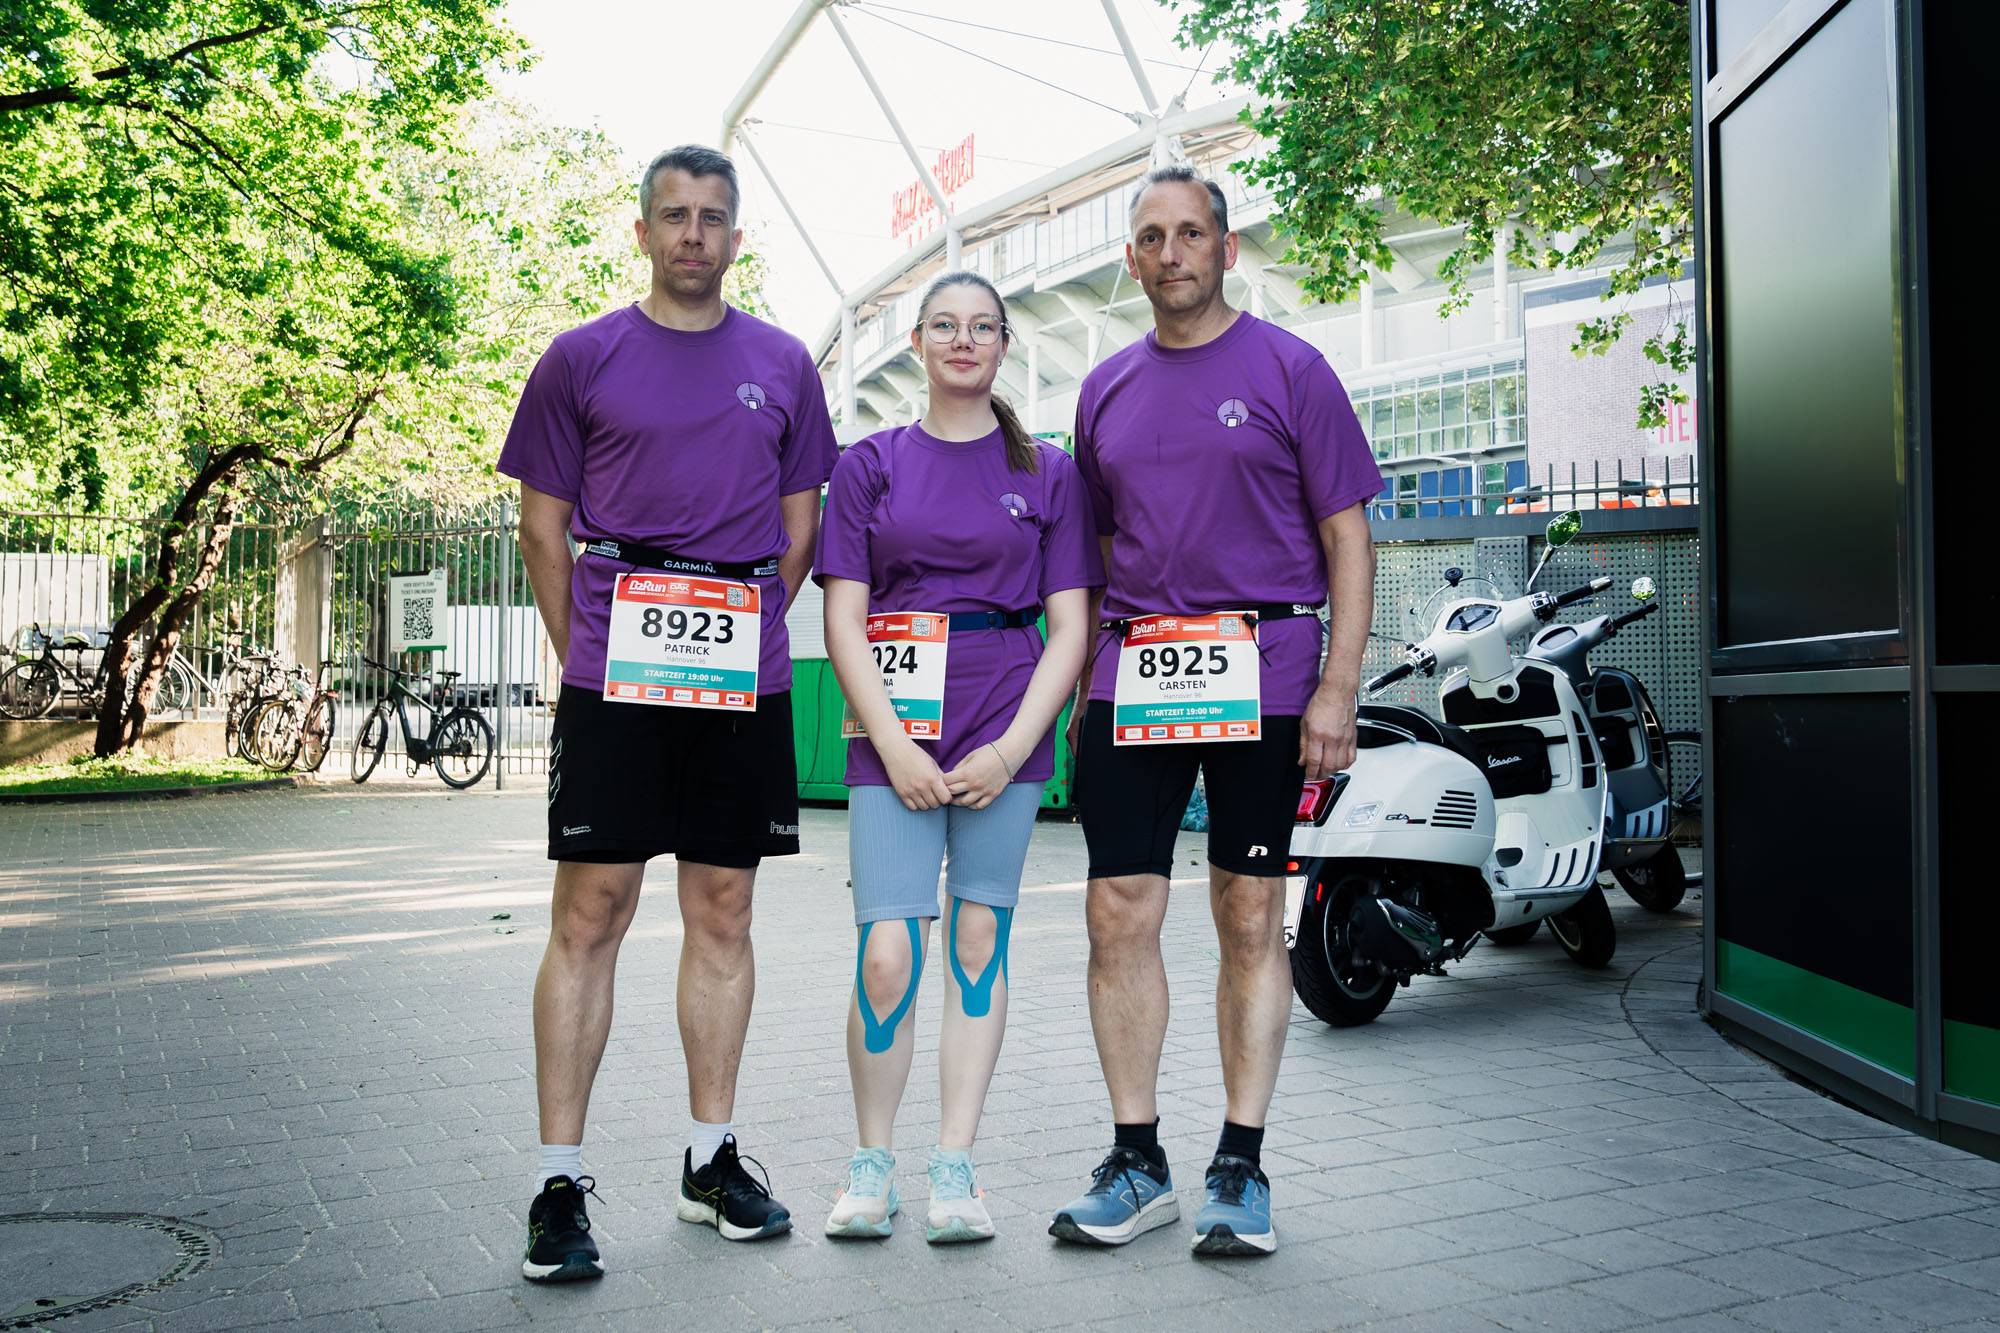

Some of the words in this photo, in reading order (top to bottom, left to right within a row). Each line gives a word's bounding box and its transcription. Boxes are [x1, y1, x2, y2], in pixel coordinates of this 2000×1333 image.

[664, 560, 713, 573] GARMIN
[628, 580, 666, 593] B2Run
[641, 608, 734, 644] 8923
[664, 644, 710, 656] PATRICK
[666, 656, 696, 664] Hannover
[698, 657, 706, 665] 96
[1138, 645, 1229, 679] 8925
[644, 669, 686, 680] STARTZEIT
[688, 672, 708, 681] 19:00
[711, 674, 724, 683] Uhr
[1159, 680, 1207, 691] CARSTEN
[1163, 692, 1191, 700] Hannover
[1145, 708, 1184, 717] STARTZEIT
[1186, 707, 1208, 715] 19:00
[1209, 706, 1224, 715] Uhr
